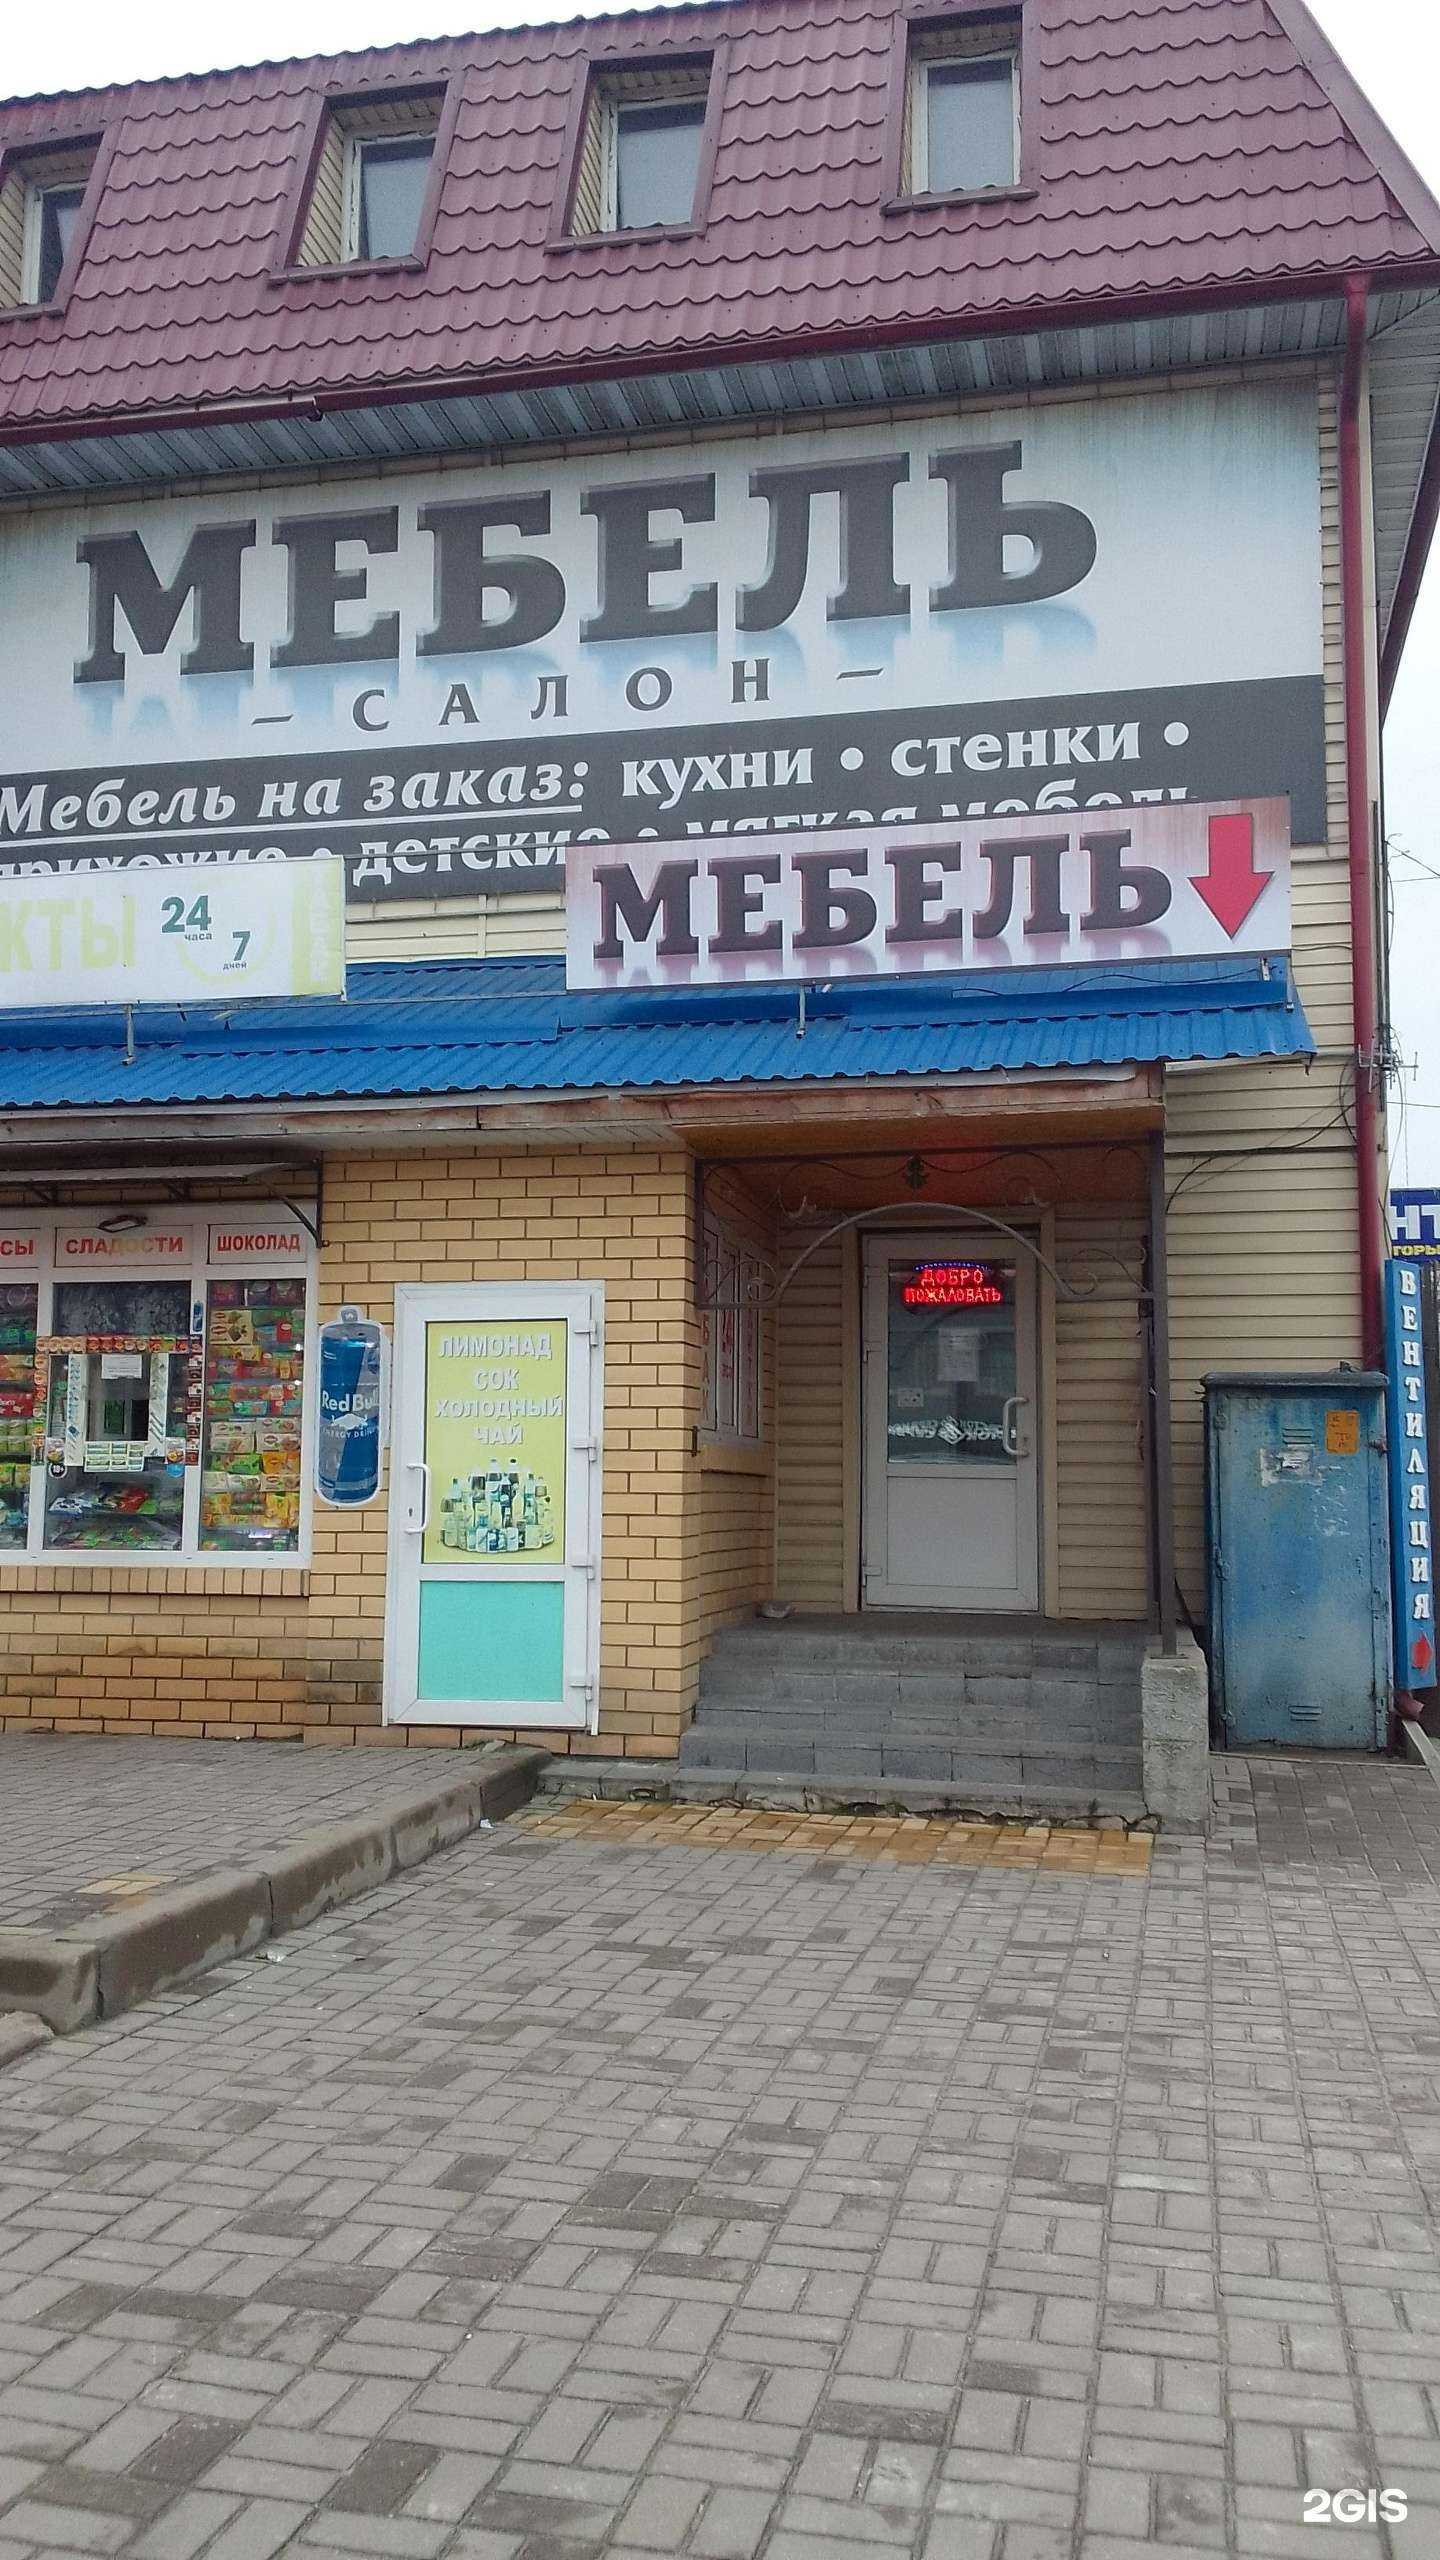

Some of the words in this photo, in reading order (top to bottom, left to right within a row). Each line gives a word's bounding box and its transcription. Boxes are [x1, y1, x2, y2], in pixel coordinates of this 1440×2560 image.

[73, 441, 1097, 684] МЕБЕЛЬ
[352, 657, 770, 732] САЛОН
[0, 777, 237, 834] Мебель
[257, 777, 343, 818] на
[363, 761, 589, 813] заказ:
[621, 747, 814, 811] кухни
[890, 721, 1141, 777] стенки
[593, 829, 1172, 960] МЕБЕЛЬ
[161, 894, 212, 934] 24
[184, 931, 213, 942] часа
[232, 930, 251, 962] 7
[222, 960, 248, 971] дней
[65, 1236, 184, 1255] СЛАДОСТИ
[217, 1233, 301, 1252] ШОКОЛАД
[920, 1268, 985, 1286] ДОБРО
[905, 1286, 1002, 1304] ПОЖАЛОВАТЬ
[438, 1334, 553, 1361] ЛИМОНАД
[473, 1368, 521, 1392] СОК
[322, 1390, 350, 1412] Red
[433, 1395, 564, 1421] ХОЛОДНЫЙ
[473, 1421, 525, 1446] ЧАЙ
[1399, 1269, 1430, 1621] ВЕНТИЛЯЦИЯ
